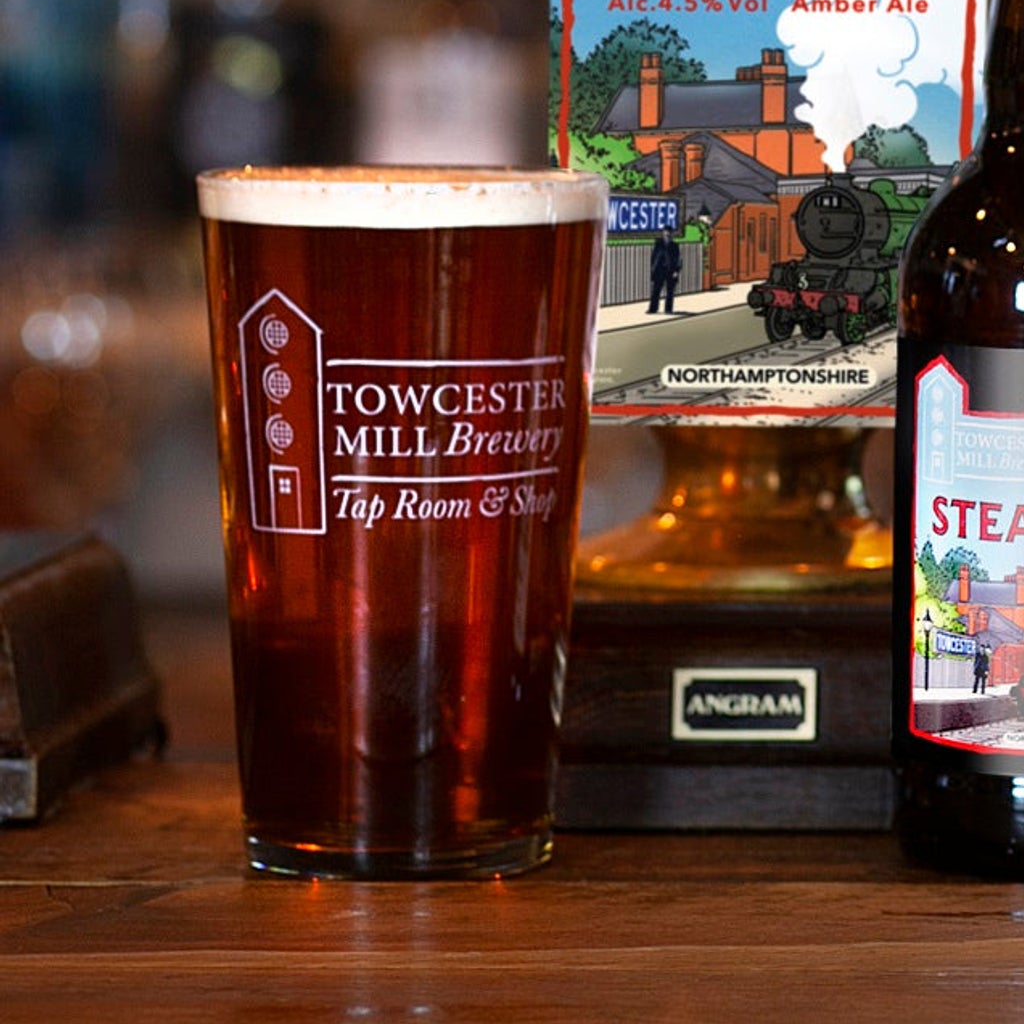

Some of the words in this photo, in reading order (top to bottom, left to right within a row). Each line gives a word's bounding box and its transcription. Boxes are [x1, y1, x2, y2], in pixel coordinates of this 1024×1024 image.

[667, 367, 869, 384] NORTHAMPTONSHIRE
[327, 378, 565, 416] TOWCESTER
[334, 425, 437, 457] MILL
[443, 422, 564, 462] Brewery
[957, 450, 997, 469] MILL
[332, 488, 384, 528] Tap
[392, 488, 472, 519] Room
[478, 487, 509, 517] &
[510, 485, 557, 521] Shop
[687, 693, 803, 716] ANGRAM
